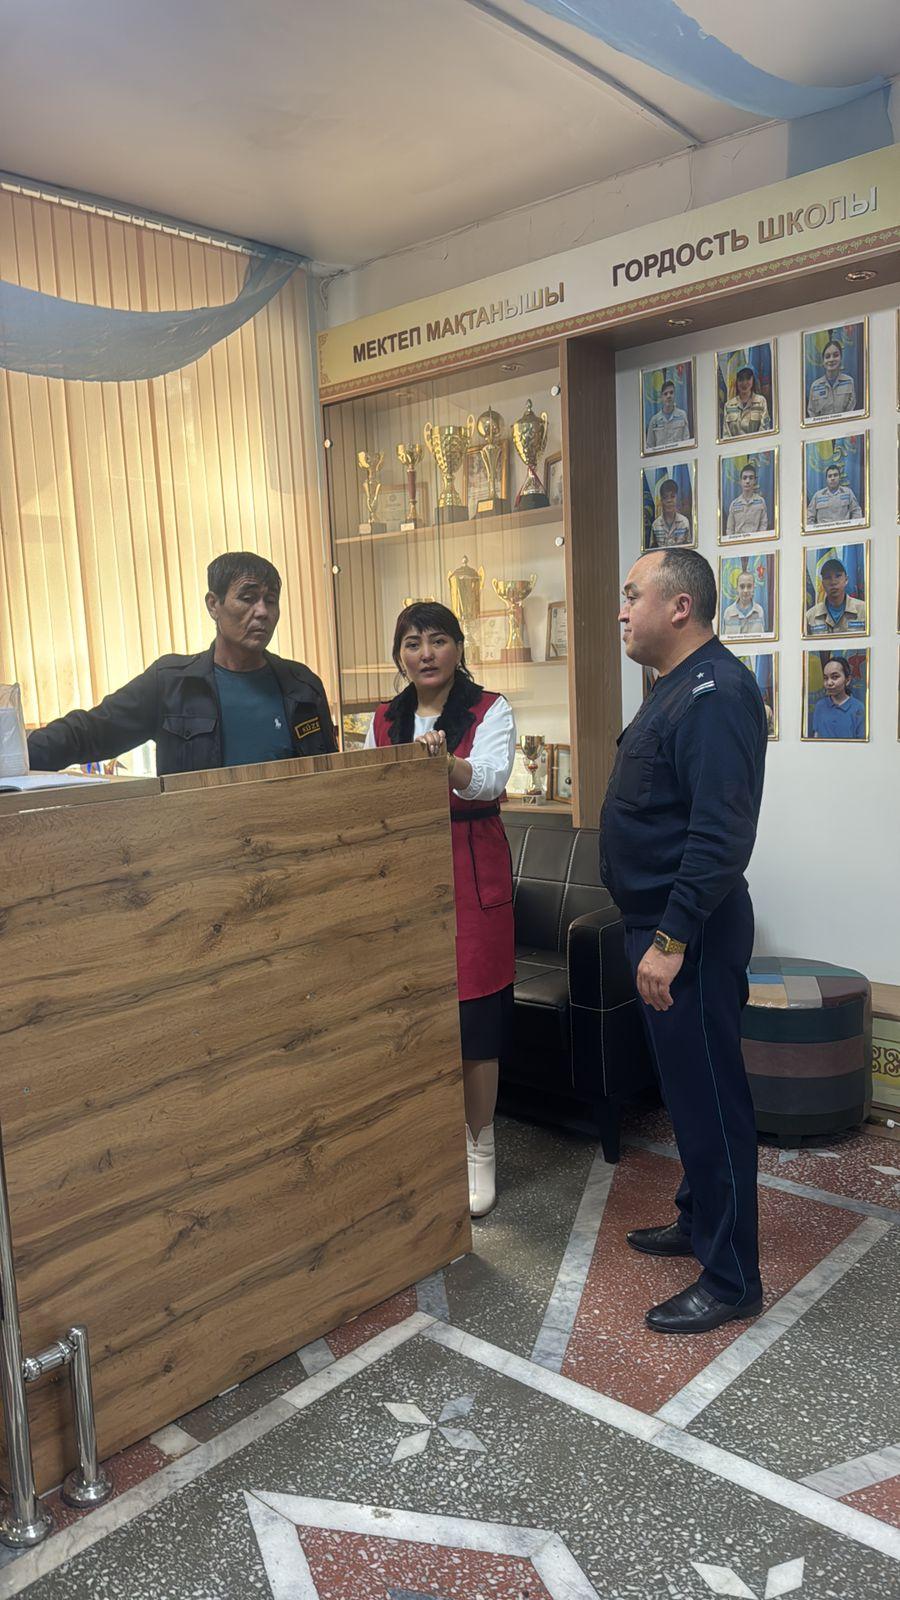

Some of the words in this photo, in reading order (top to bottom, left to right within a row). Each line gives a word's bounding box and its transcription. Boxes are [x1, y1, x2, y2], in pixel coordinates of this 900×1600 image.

[612, 229, 749, 286] ГОРДОСТЬ
[758, 186, 878, 244] ШКОЛЫ
[353, 327, 421, 363] МЕКТЕП
[426, 282, 565, 342] МАҚТАНЫШЫ
